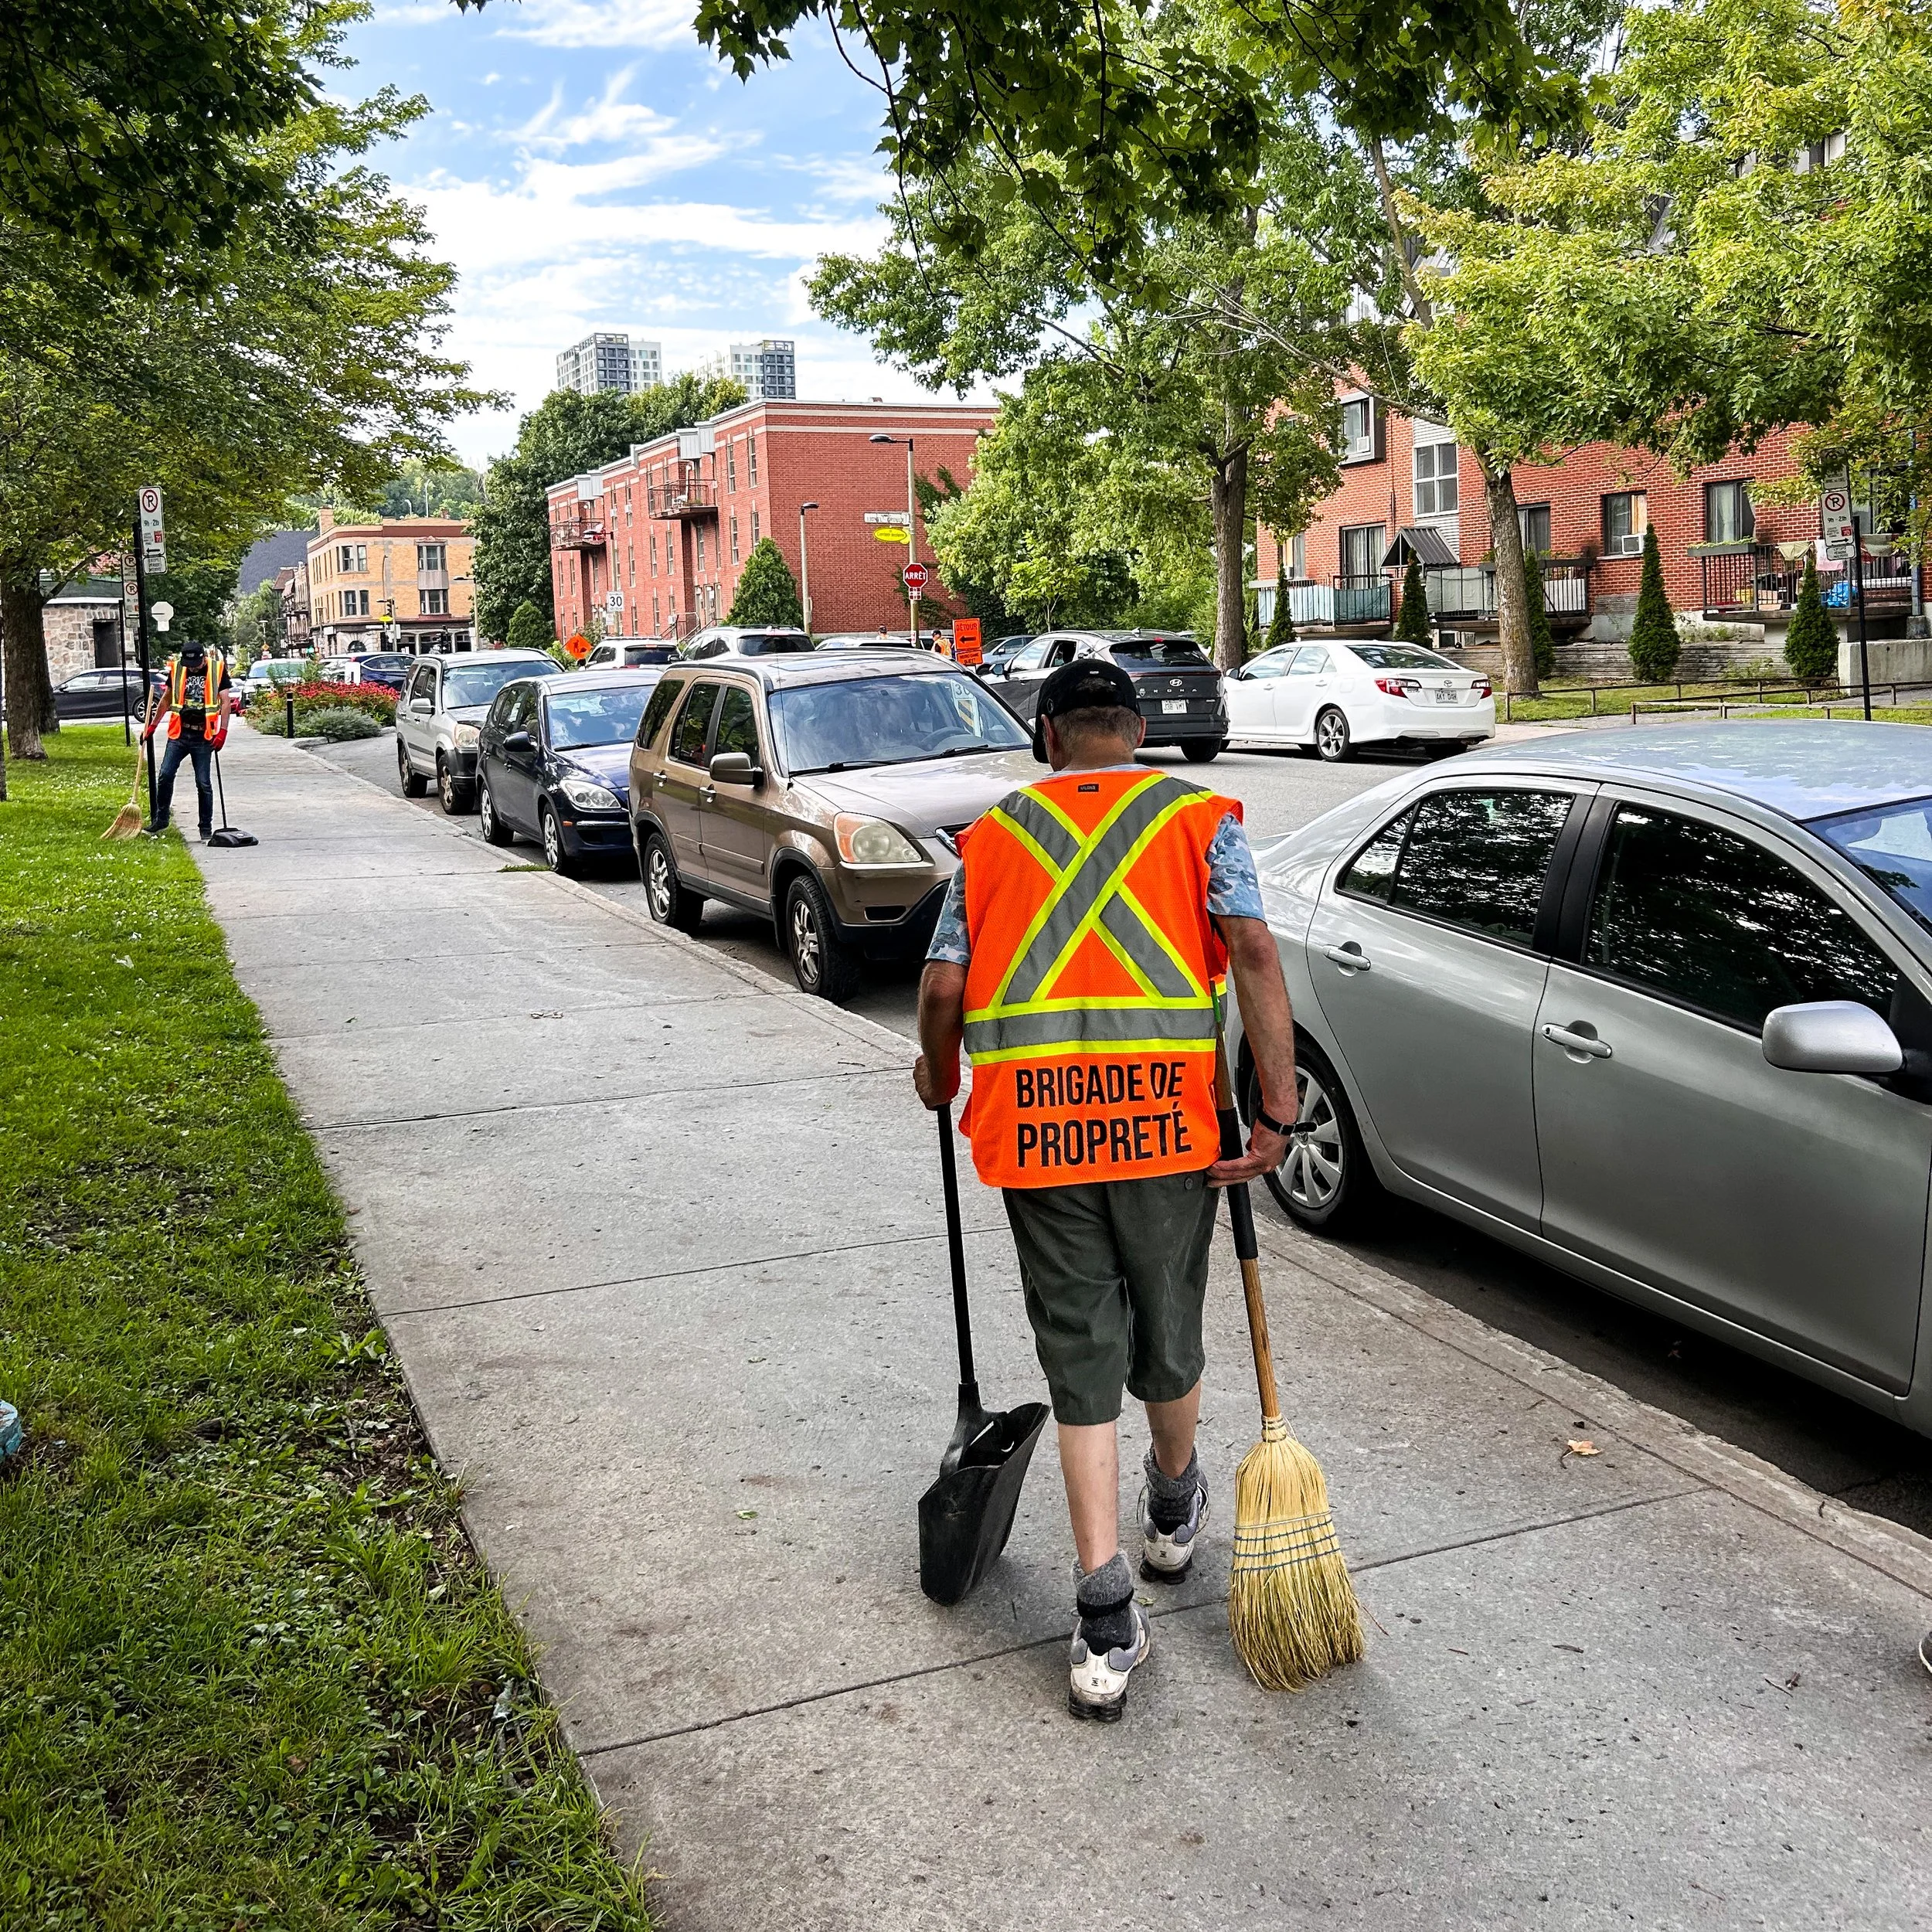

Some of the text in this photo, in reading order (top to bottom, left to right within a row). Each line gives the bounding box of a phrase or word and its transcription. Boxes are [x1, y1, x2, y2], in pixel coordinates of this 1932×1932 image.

[905, 570, 927, 580] ARRÊT
[610, 596, 622, 607] 30
[956, 623, 978, 631] DÉTOUR
[1015, 1061, 1186, 1109] BRIGADE DE
[1017, 1100, 1192, 1168] PROPRETÉ
